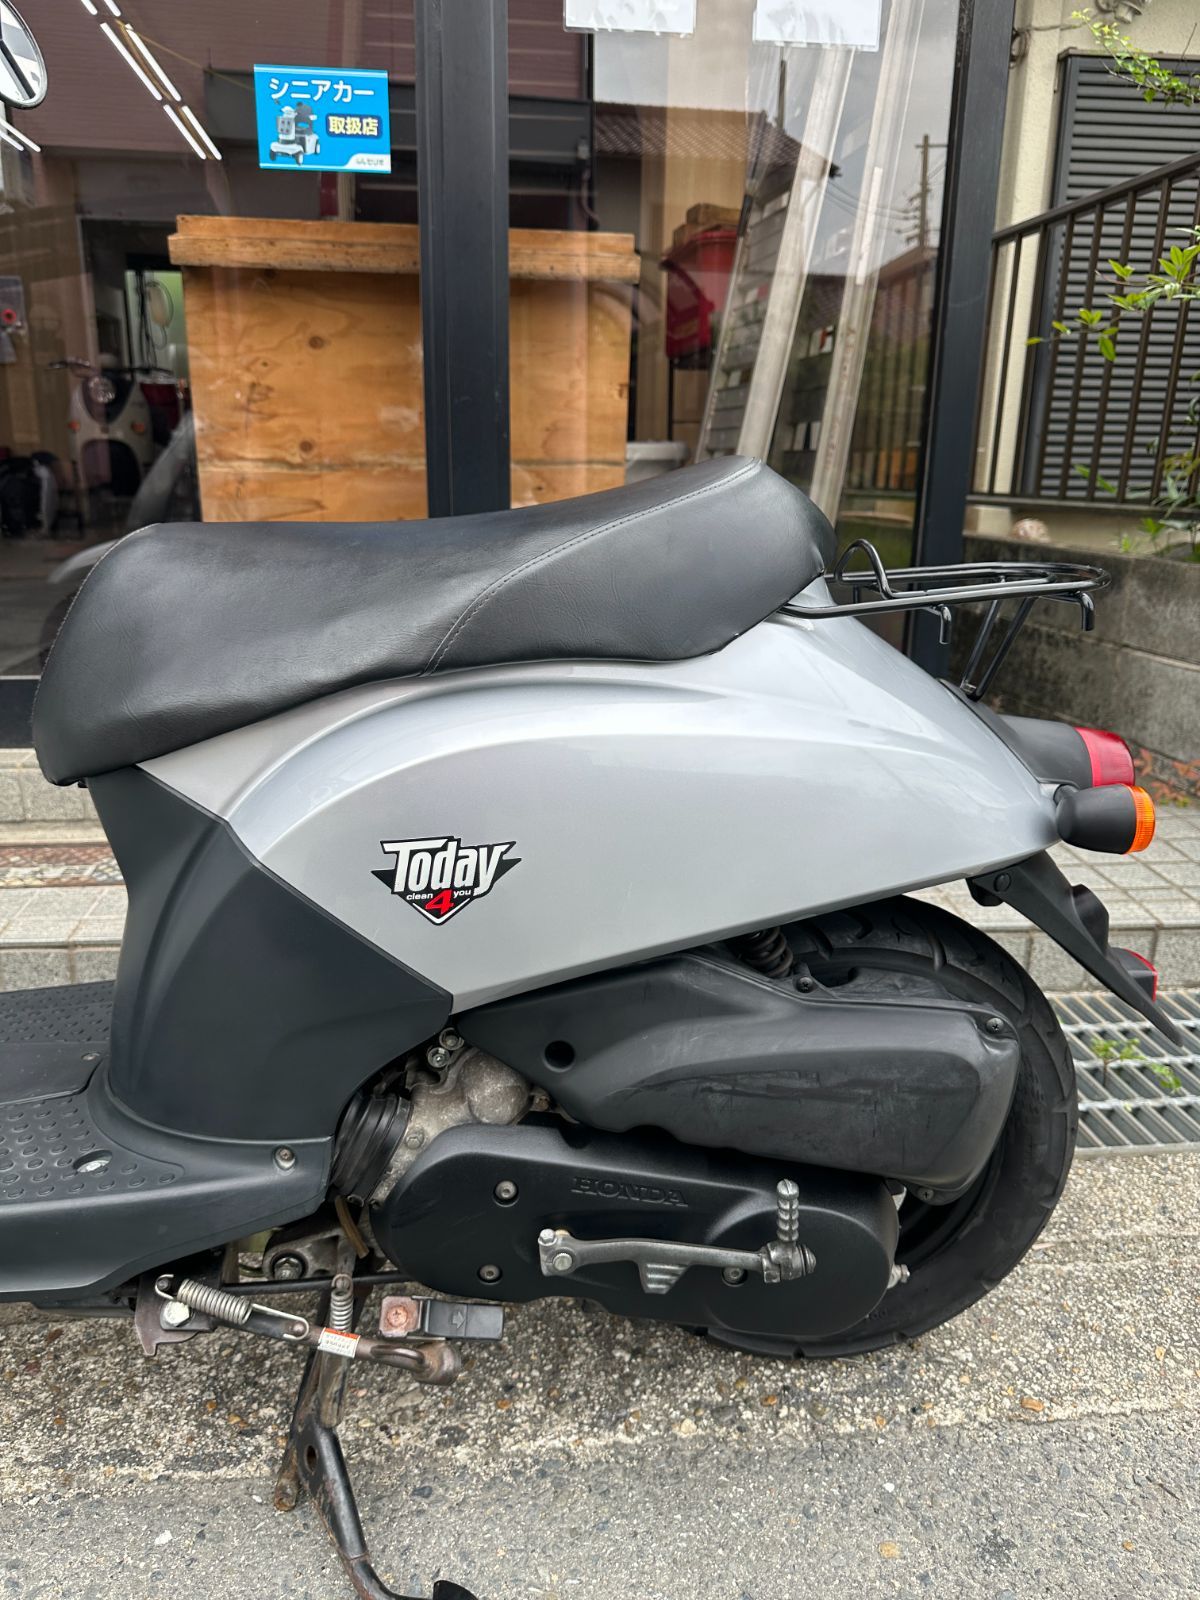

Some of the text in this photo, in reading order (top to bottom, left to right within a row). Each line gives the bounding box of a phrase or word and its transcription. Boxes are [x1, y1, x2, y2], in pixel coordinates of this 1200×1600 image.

[269, 78, 375, 103] シニアカー
[328, 115, 379, 137] 取扱店
[382, 838, 511, 896] Today
[406, 889, 472, 915] clean 4 you
[570, 1176, 689, 1207] HONDA
